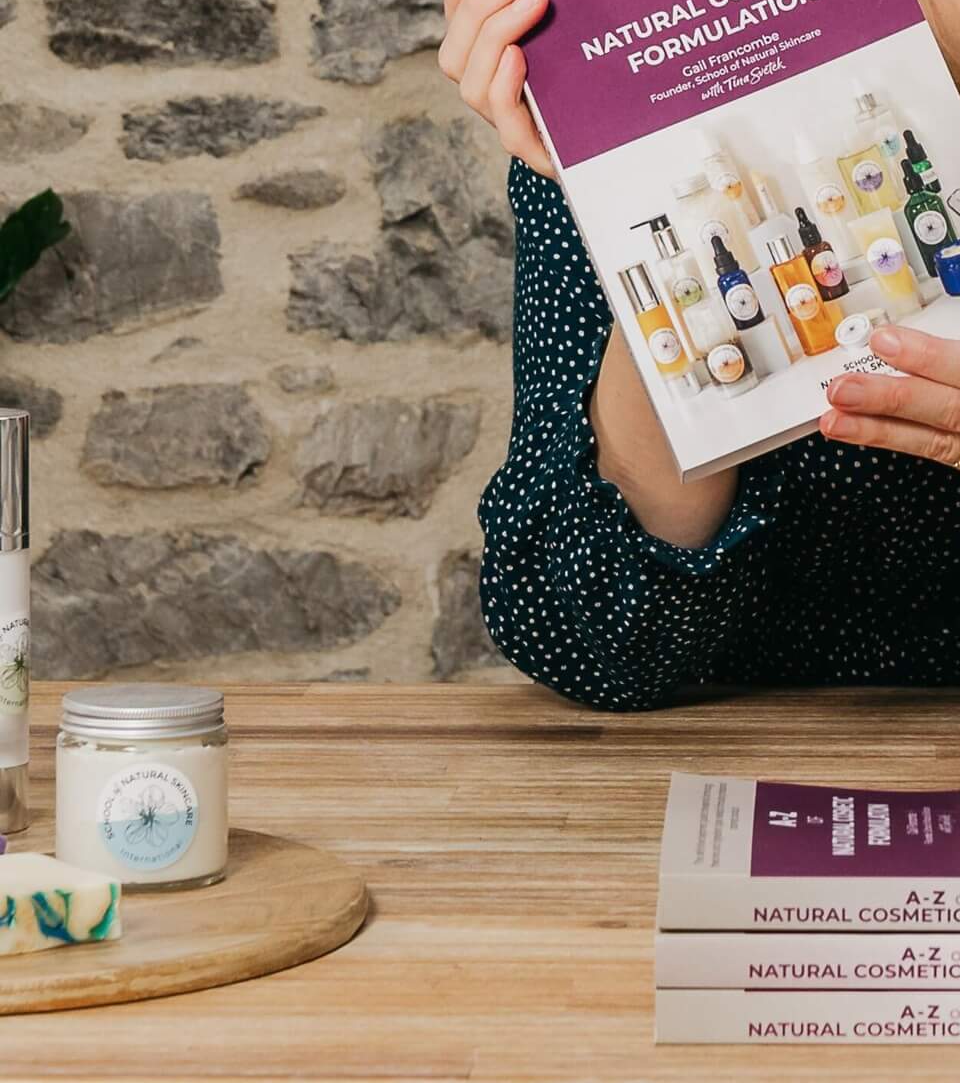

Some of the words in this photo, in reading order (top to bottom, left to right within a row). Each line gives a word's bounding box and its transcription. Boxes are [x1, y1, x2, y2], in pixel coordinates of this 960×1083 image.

[682, 59, 706, 77] Gail
[708, 32, 780, 63] Francombe
[649, 81, 696, 104] Founder,
[695, 64, 729, 85] School
[730, 60, 742, 72] of
[742, 45, 779, 67] Natural
[779, 28, 822, 53] Skincare
[701, 82, 726, 101] with
[723, 73, 750, 92] Tina
[843, 353, 880, 371] SCHOOL
[121, 770, 170, 786] NATURAL
[171, 777, 194, 827] SKINCARE
[906, 890, 946, 906] A-Z
[754, 908, 852, 924] NATURAL
[901, 947, 941, 961] A-Z
[749, 964, 848, 979] NATURAL
[900, 1004, 940, 1020] A-Z
[748, 1022, 846, 1037] NATURAL
[853, 1022, 960, 1037] COSMETIC
